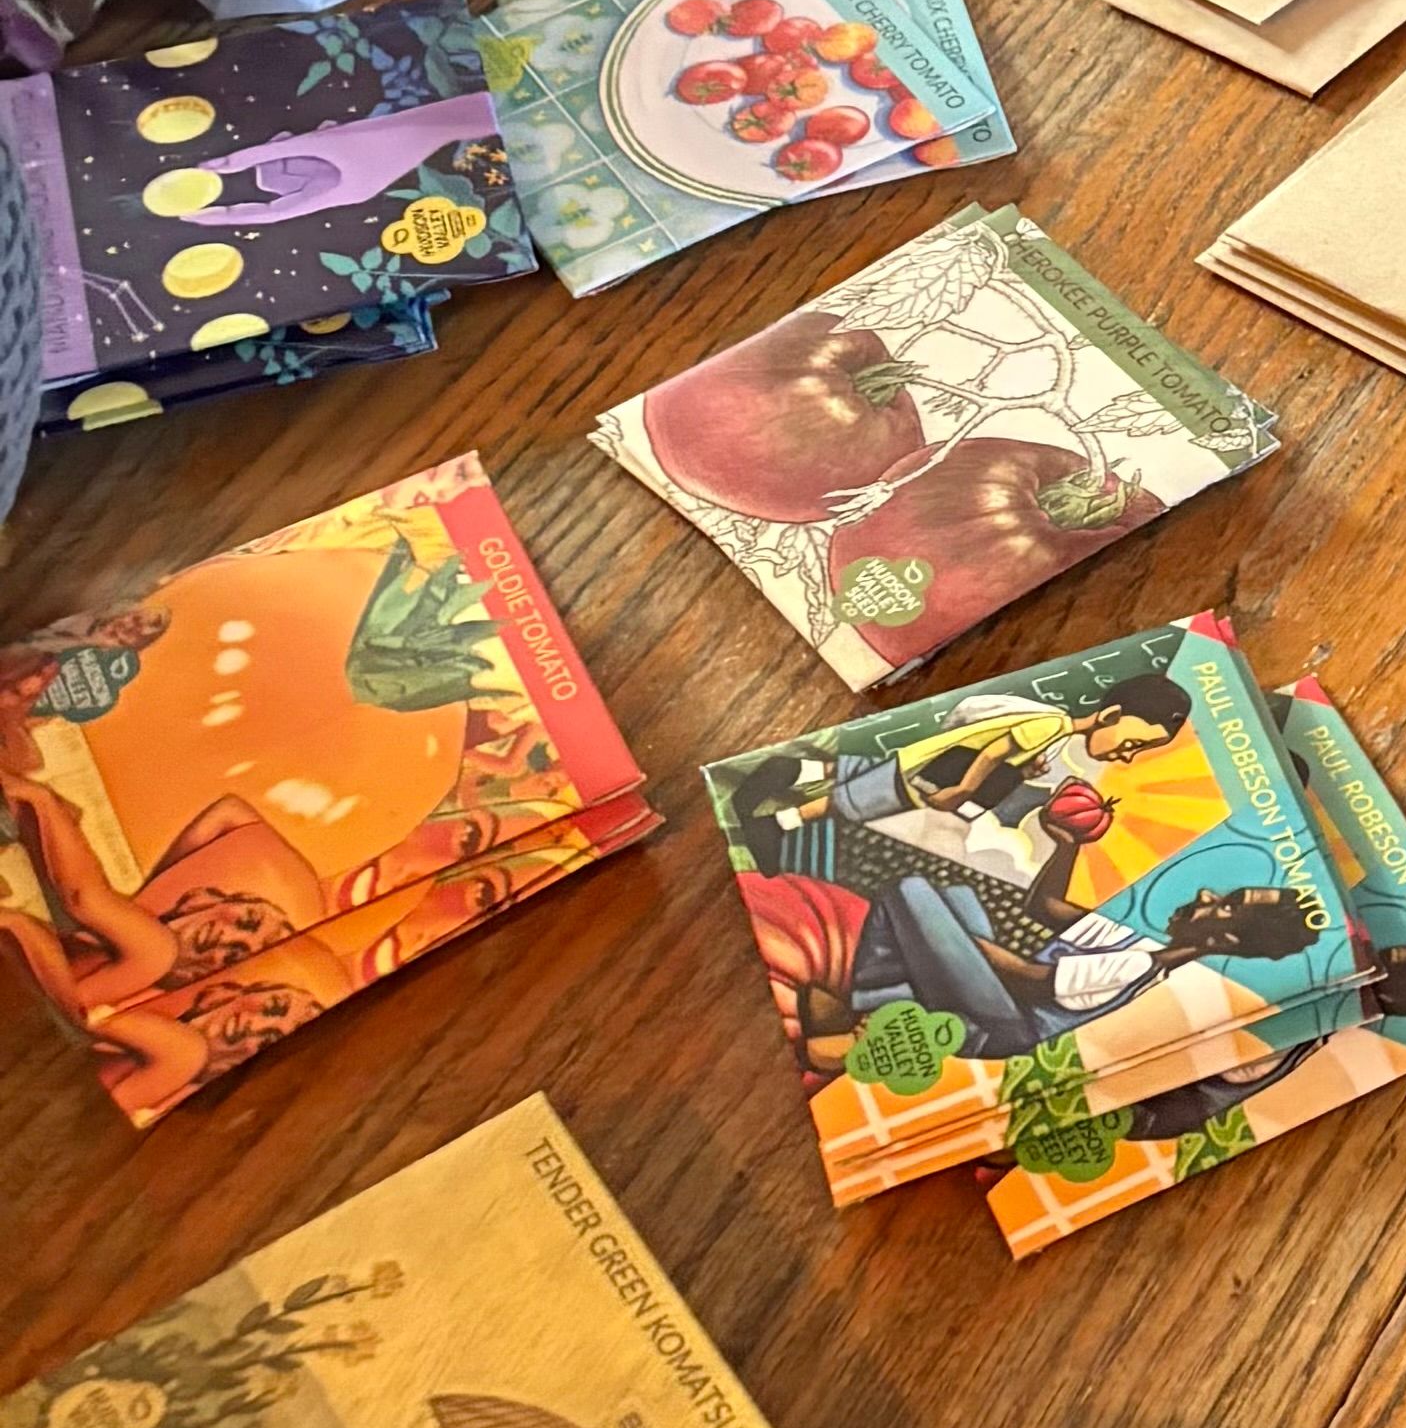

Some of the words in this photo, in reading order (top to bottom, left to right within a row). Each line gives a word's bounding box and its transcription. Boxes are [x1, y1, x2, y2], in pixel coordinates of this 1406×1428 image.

[903, 46, 966, 110] TOMATO
[1086, 305, 1159, 367] PURPLE
[1151, 361, 1233, 434] TOMATO
[841, 602, 859, 618] CO
[844, 585, 880, 617] SEED
[855, 569, 905, 615] VALLEY
[865, 558, 922, 612] HUDSON
[478, 537, 534, 613] GOLDIE
[515, 609, 578, 702] TOMATO
[1303, 724, 1353, 781] PAUL
[1192, 660, 1235, 720] PAUL
[1217, 717, 1287, 828] ROBESON
[1269, 825, 1333, 933] TOMATO
[866, 1035, 894, 1077] SEED
[883, 1018, 919, 1077] VALLEY
[899, 1007, 937, 1078] HUDSON
[524, 1137, 602, 1239] TENDER
[588, 1232, 660, 1319] GREEN
